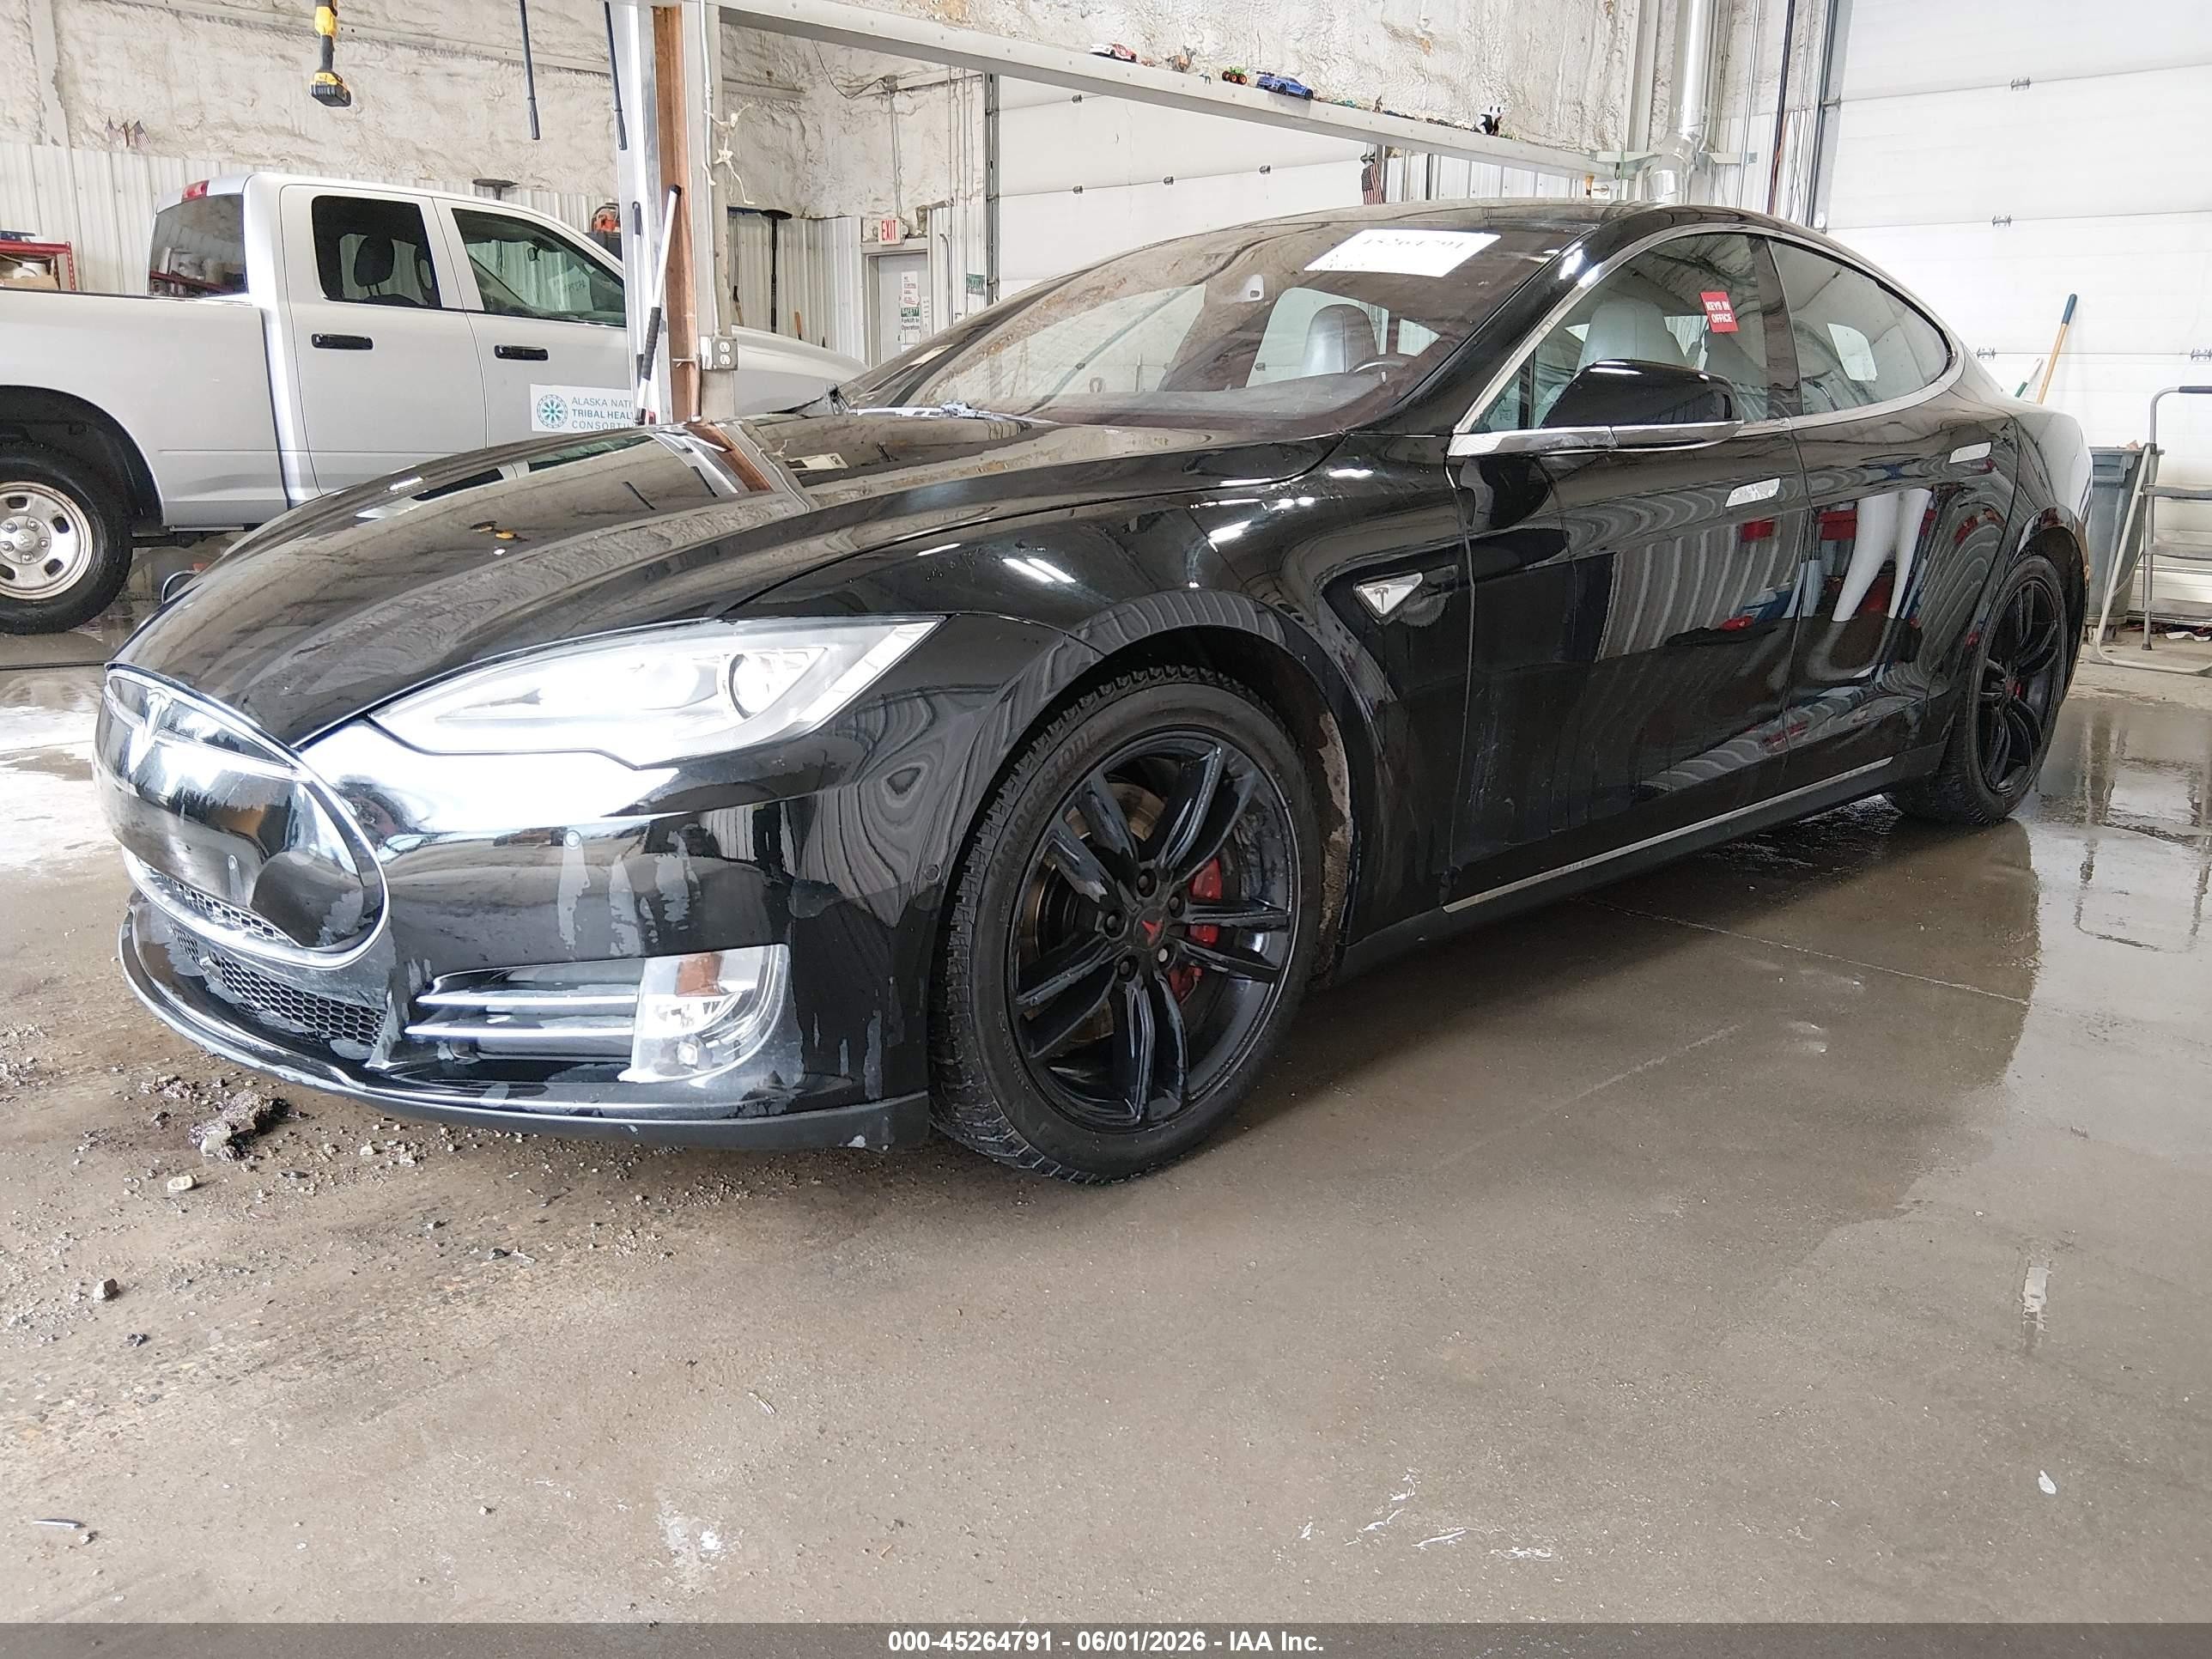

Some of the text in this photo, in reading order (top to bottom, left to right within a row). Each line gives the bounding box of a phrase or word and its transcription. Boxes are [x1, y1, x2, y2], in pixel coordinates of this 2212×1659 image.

[881, 219, 896, 241] EXIT
[1705, 301, 1730, 311] KEYS IN
[1711, 313, 1733, 323] OFFICE
[572, 396, 633, 408] ALASKA NATI
[572, 409, 605, 419] TRIBAL
